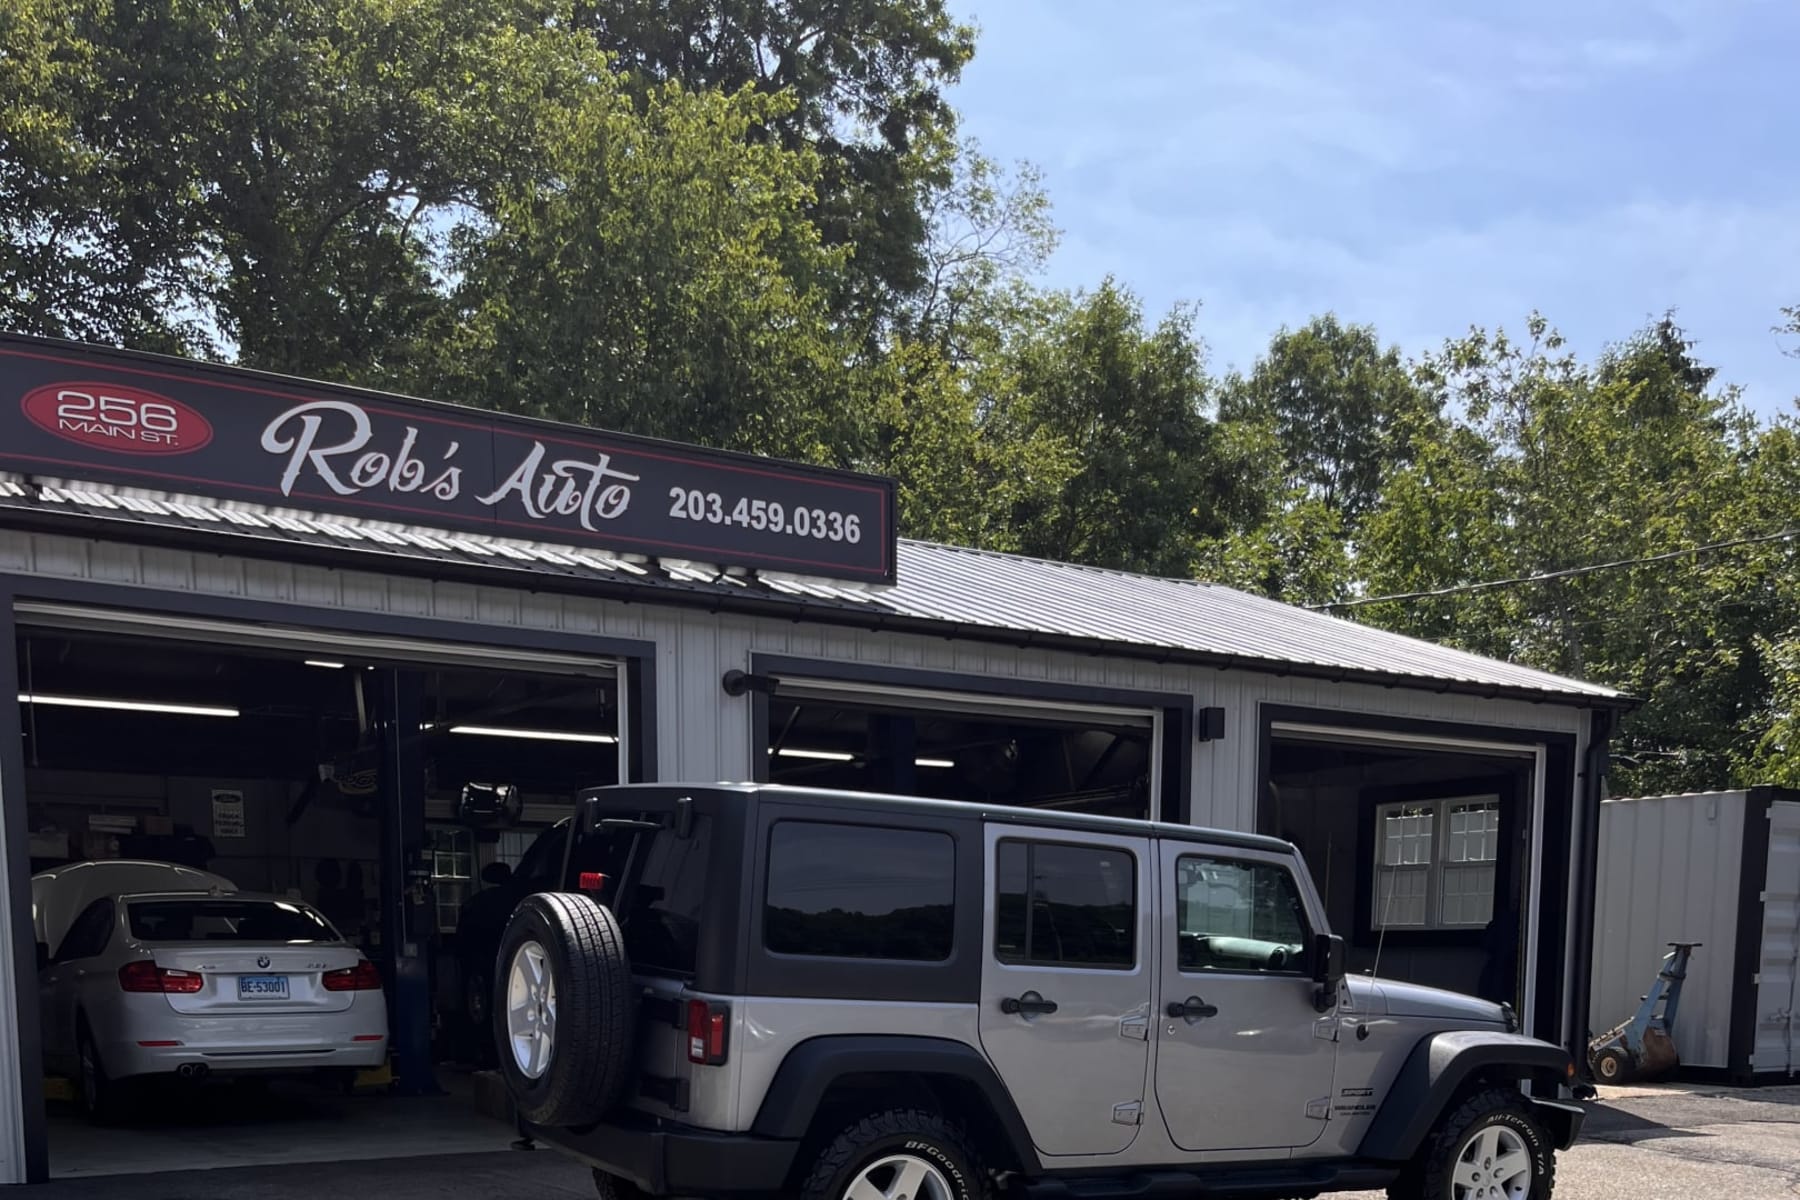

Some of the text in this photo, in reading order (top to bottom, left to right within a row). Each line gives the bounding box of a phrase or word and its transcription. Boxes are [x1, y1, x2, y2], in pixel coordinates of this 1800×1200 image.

[57, 388, 178, 432] 256
[59, 419, 179, 446] MAIN ST.
[260, 400, 640, 532] Rob's Auto
[668, 486, 861, 544] 203.459.0336
[1486, 1113, 1545, 1175] All-Terrain T/A
